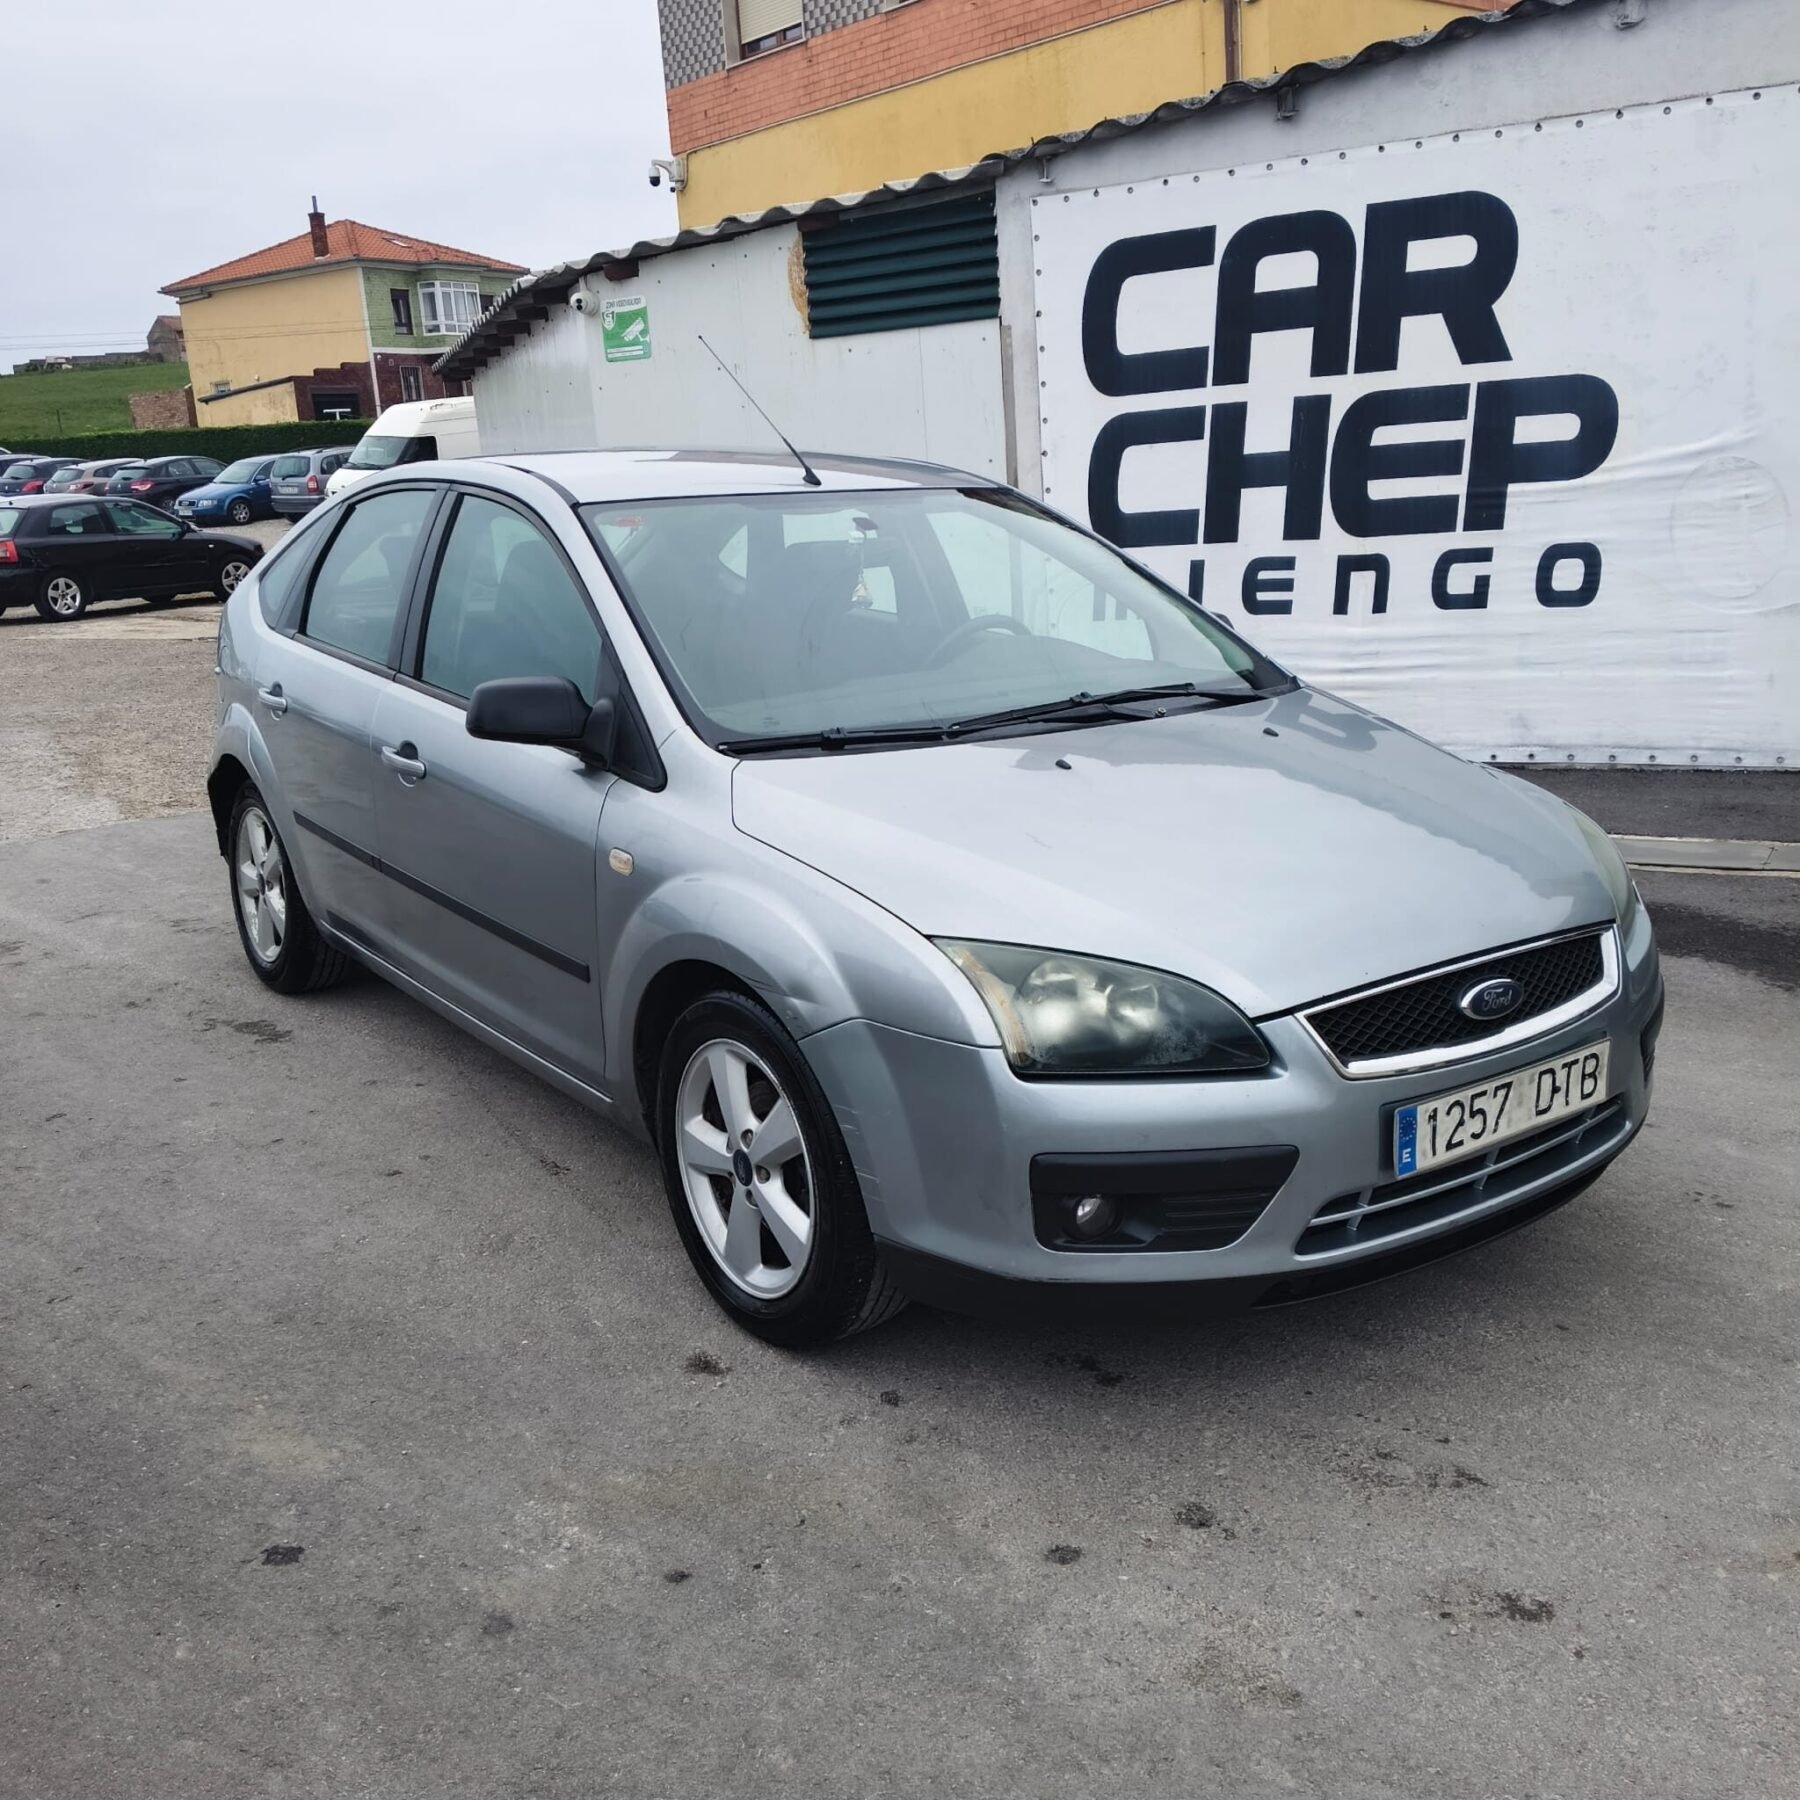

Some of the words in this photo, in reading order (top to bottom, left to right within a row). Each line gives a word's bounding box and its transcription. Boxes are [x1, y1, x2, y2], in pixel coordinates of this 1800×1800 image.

[1082, 190, 1519, 397] CAR
[1088, 373, 1620, 549] CHEP
[1482, 987, 1513, 1011] Ford
[1402, 1147, 1412, 1163] E
[1427, 1080, 1514, 1157] 1257
[1535, 1052, 1600, 1117] DTB
